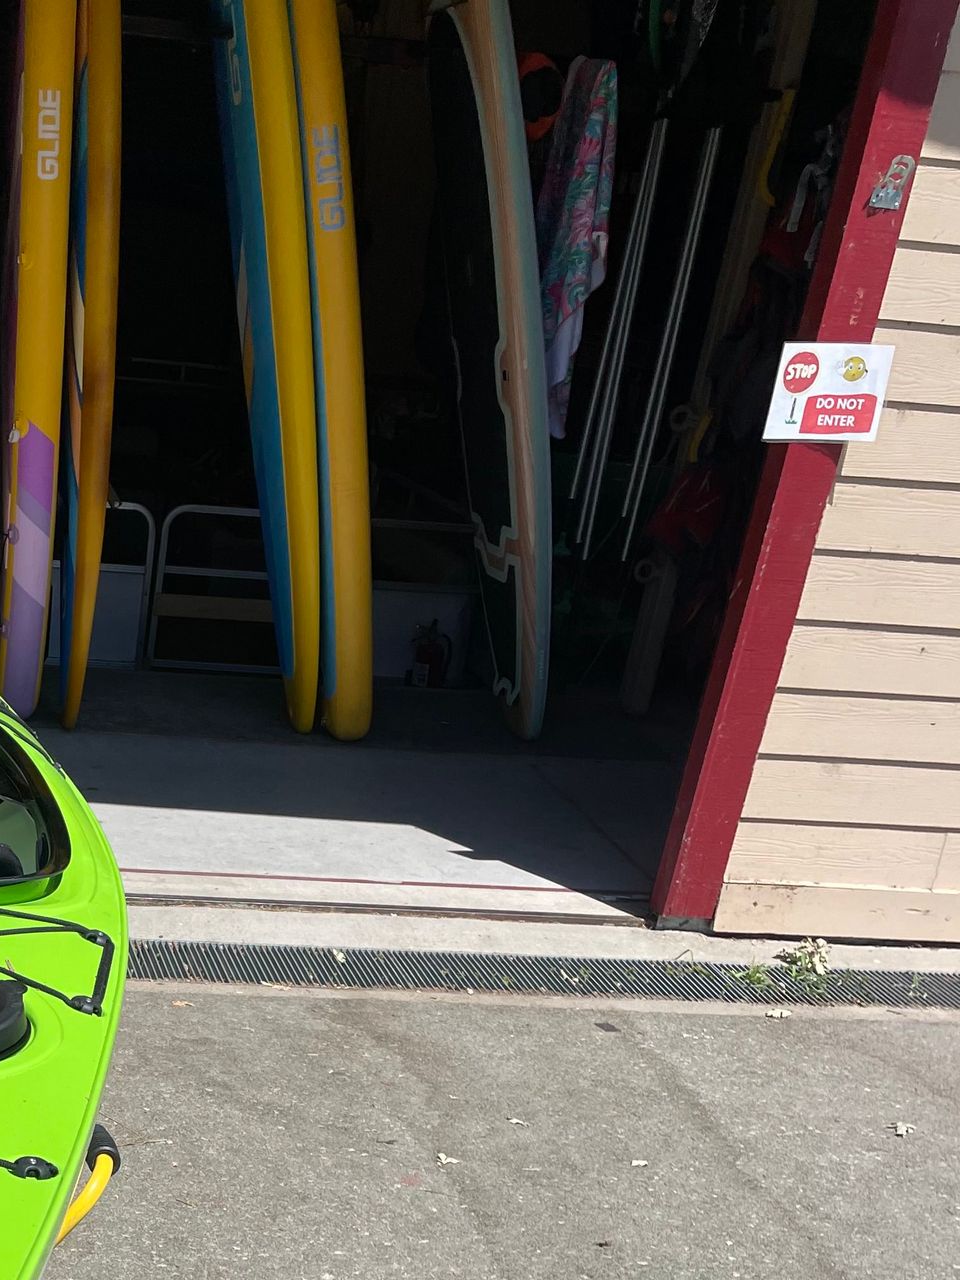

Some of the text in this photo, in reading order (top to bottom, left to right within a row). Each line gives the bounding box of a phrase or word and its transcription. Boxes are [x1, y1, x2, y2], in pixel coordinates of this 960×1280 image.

[38, 89, 60, 180] GLIDE
[312, 125, 346, 231] GLIDE
[785, 363, 818, 381] STOP
[815, 397, 865, 411] DO NOT
[816, 413, 856, 428] ENTER
